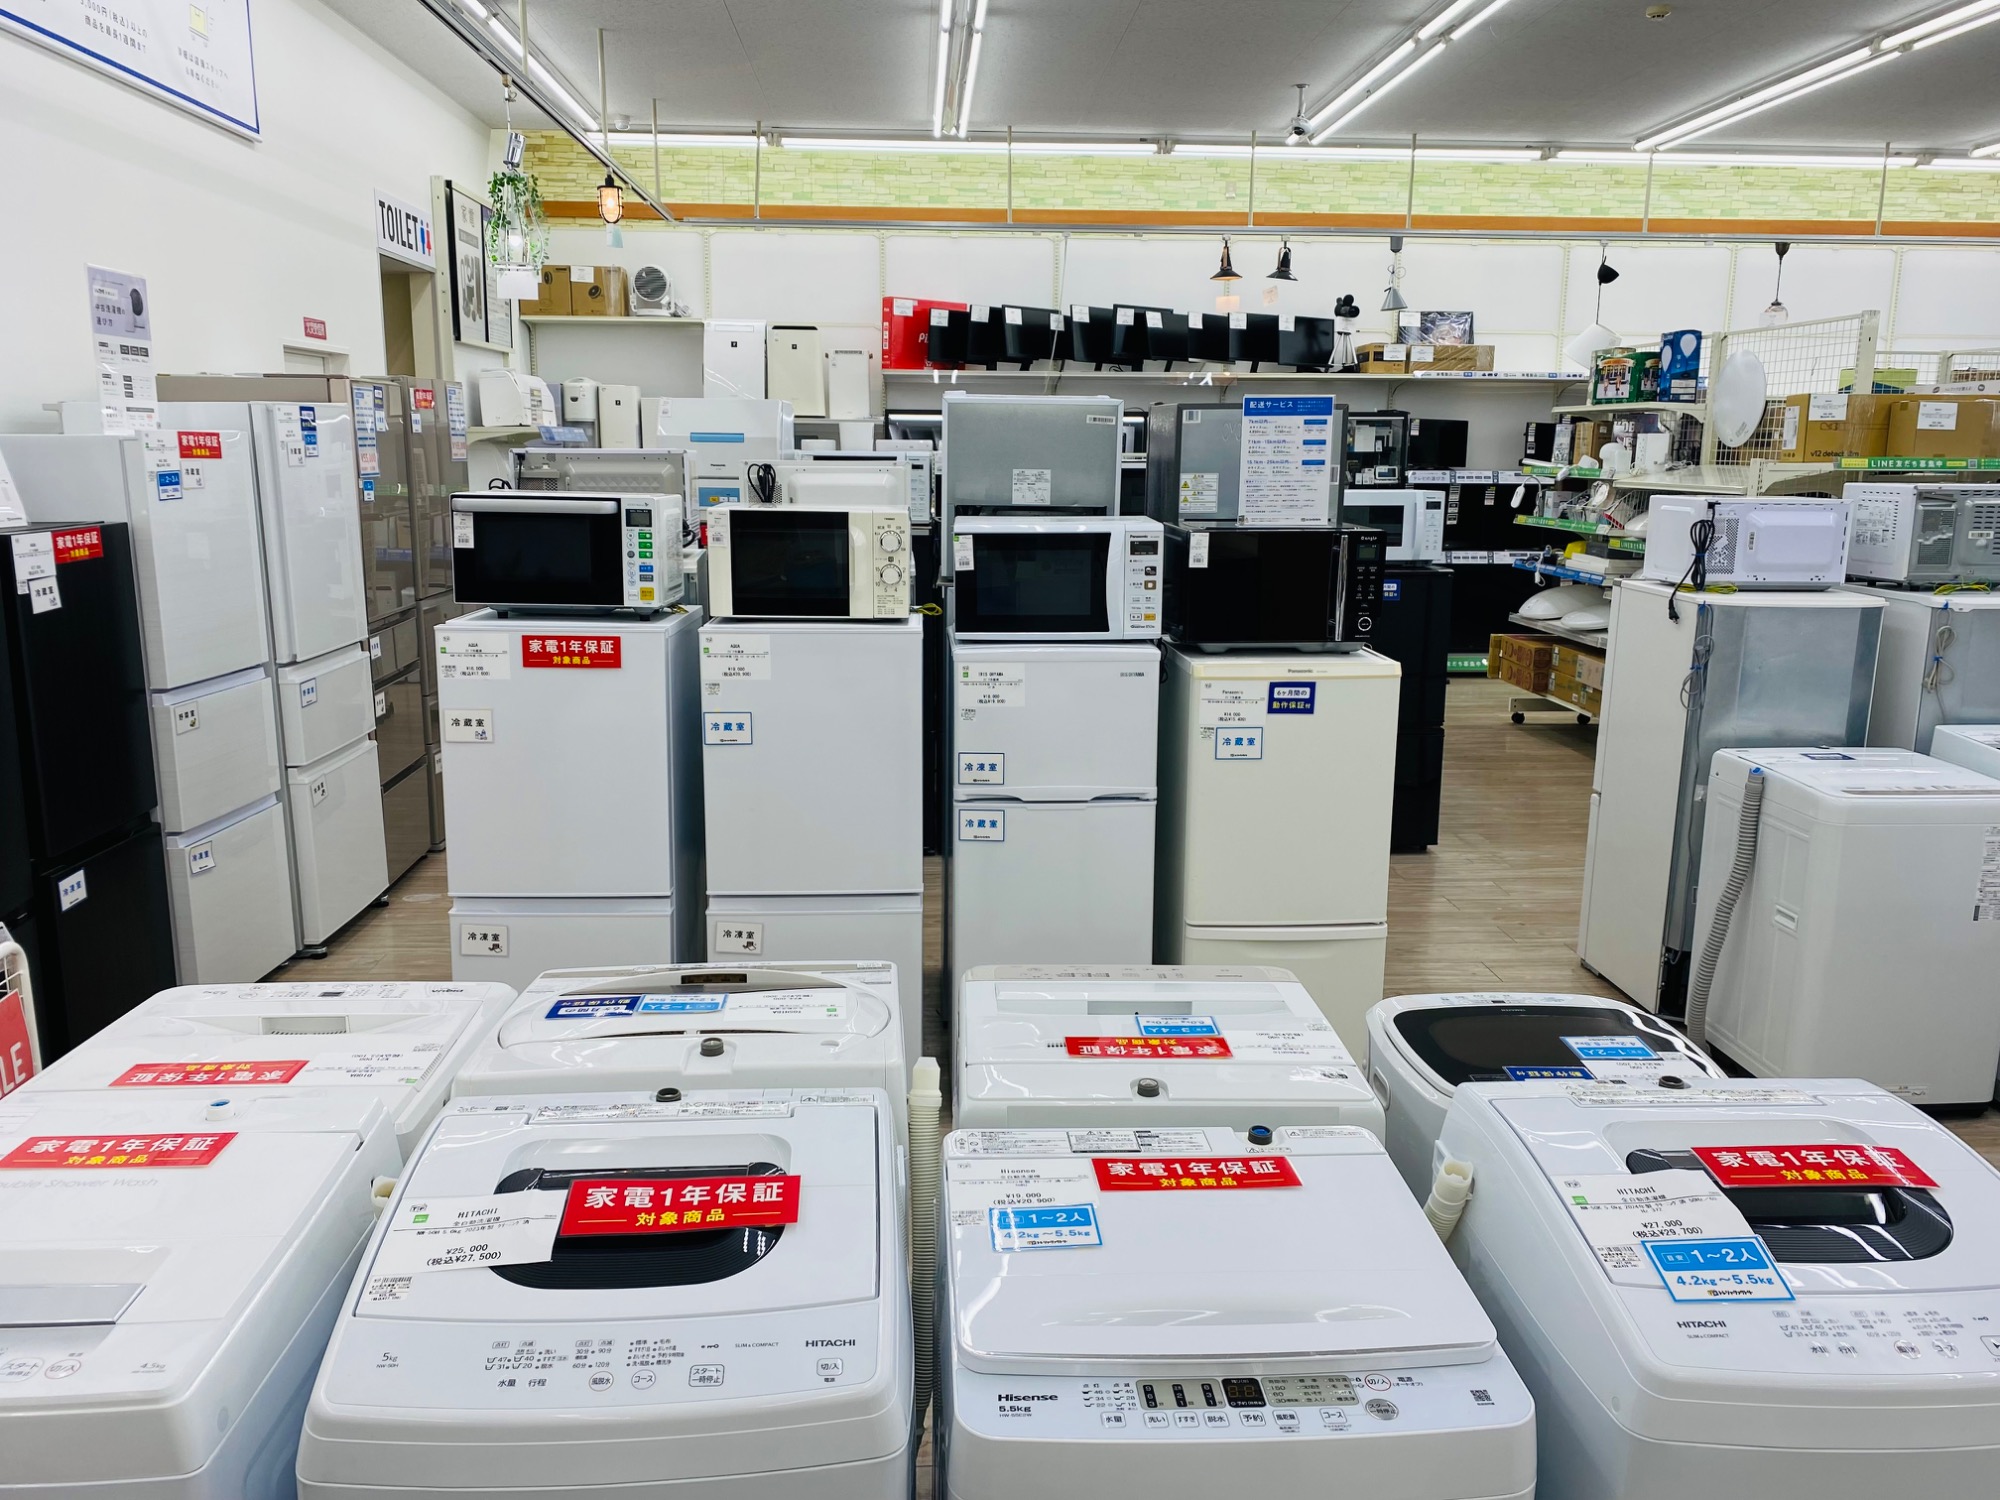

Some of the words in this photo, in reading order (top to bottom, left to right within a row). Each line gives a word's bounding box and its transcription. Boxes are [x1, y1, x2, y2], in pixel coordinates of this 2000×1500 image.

[378, 200, 420, 252] TOILET
[1249, 401, 1294, 409] 配送サービス
[180, 435, 219, 446] 家電1年保証
[1871, 460, 1943, 468] LINE友だち募集中
[56, 531, 99, 550] 家電1年保証
[528, 640, 615, 654] 家電1年保証
[552, 656, 591, 665] 対象商品
[1272, 701, 1311, 709] 動作保証付
[451, 718, 485, 728] 冷蔵室
[710, 722, 745, 731] 冷蔵室
[1222, 737, 1256, 746] 冷蔵室
[964, 763, 998, 772] 冷凍室
[965, 820, 998, 829] 冷蔵室
[467, 931, 500, 942] 冷凍室
[722, 929, 755, 940] 冷凍室
[1116, 1038, 1178, 1046] 対象商品
[1078, 1045, 1220, 1055] 家電1年保証
[186, 1063, 252, 1071] 対象商品
[126, 1070, 286, 1082] 家電1年保証
[1516, 1070, 1584, 1078] 動作保証付
[27, 1136, 220, 1154] 家電1年保証
[62, 1154, 150, 1165] 対象商品
[1711, 1149, 1905, 1168] 家電1年保証
[1107, 1160, 1280, 1176] 家電1年保証
[1780, 1169, 1868, 1181] 対象商品
[46, 1176, 112, 1188] Shower
[114, 1176, 158, 1187] Wash
[1159, 1177, 1238, 1187] 対象商品
[584, 1182, 784, 1208] 家電1年保証
[1617, 1186, 1656, 1195] HITACHI
[457, 1208, 498, 1218] HITACHI
[636, 1208, 725, 1226] 対象商品
[1028, 1212, 1085, 1223] 1～2人
[1641, 1219, 1683, 1228] ¥27,000
[1004, 1229, 1091, 1238] 42kg～5.5kg
[1632, 1226, 1703, 1238] (税込¥29,700)
[446, 1243, 488, 1255] ¥25,000
[426, 1250, 502, 1266] (税込¥27,500)
[1690, 1248, 1758, 1264] 1～2人
[1676, 1274, 1774, 1286] 4.2kg～5.5kg
[1677, 1320, 1726, 1329] HITACHI
[806, 1339, 856, 1347] HITACHI
[382, 1352, 398, 1362] 5kg
[693, 1367, 721, 1375] スタート
[498, 1379, 516, 1387] 水量
[528, 1379, 547, 1387] 行程
[634, 1375, 653, 1383] コース
[692, 1375, 721, 1384] 一時停止
[998, 1394, 1058, 1402] Hisense
[1106, 1415, 1122, 1423] 水量
[1243, 1414, 1263, 1422] 予約
